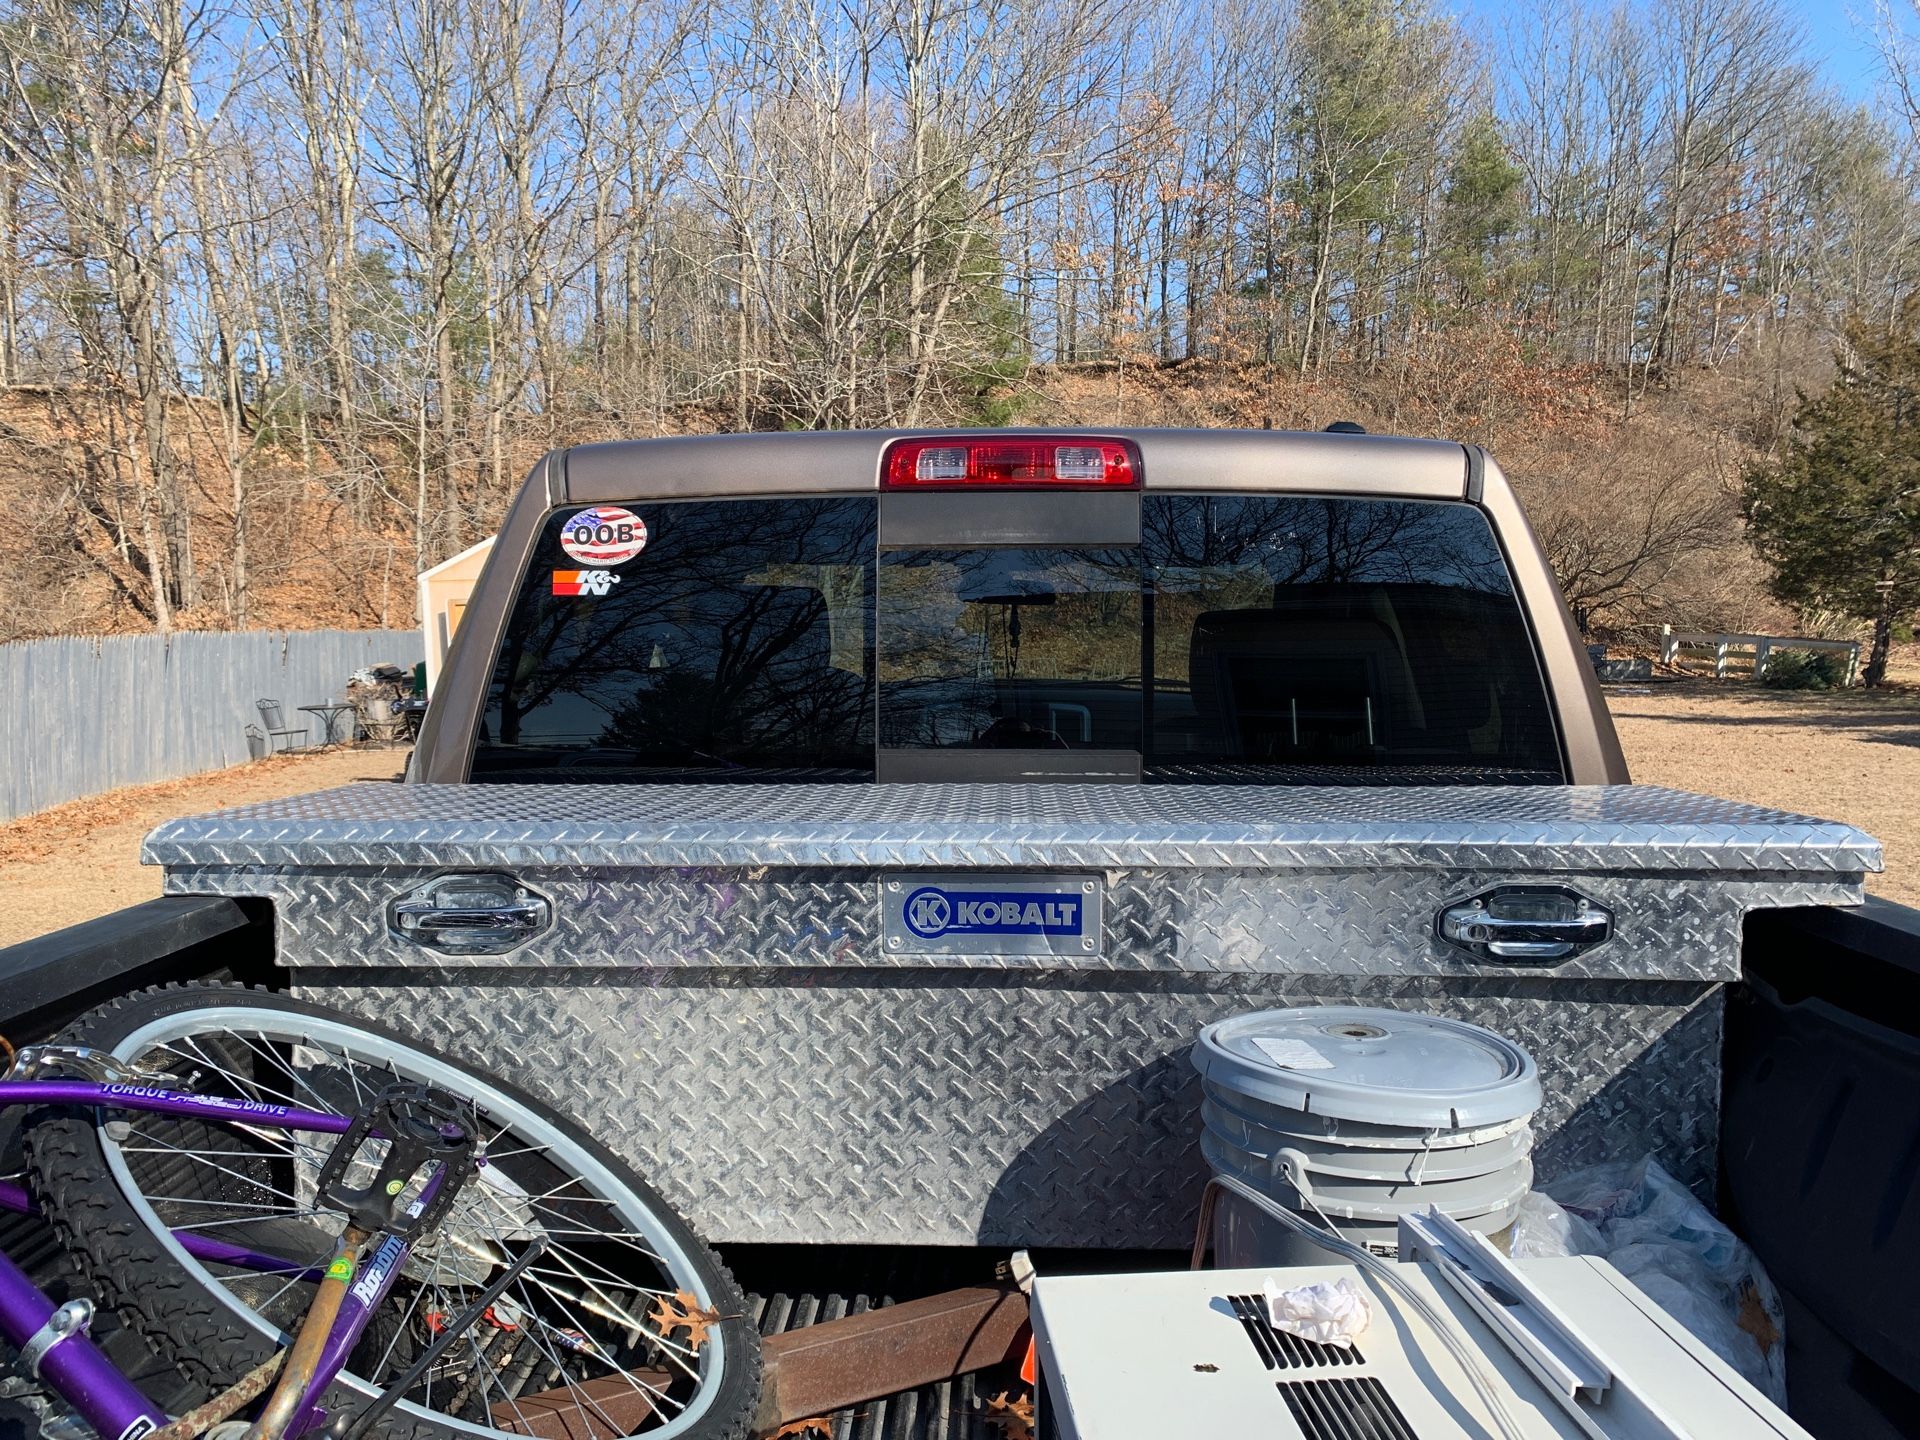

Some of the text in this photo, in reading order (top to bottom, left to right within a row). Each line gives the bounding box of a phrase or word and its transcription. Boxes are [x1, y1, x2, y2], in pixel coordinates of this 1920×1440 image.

[573, 523, 634, 546] OOB
[958, 901, 1076, 926] KOBALT
[102, 1083, 168, 1099] TORQUE
[244, 1101, 287, 1116] DRIVE
